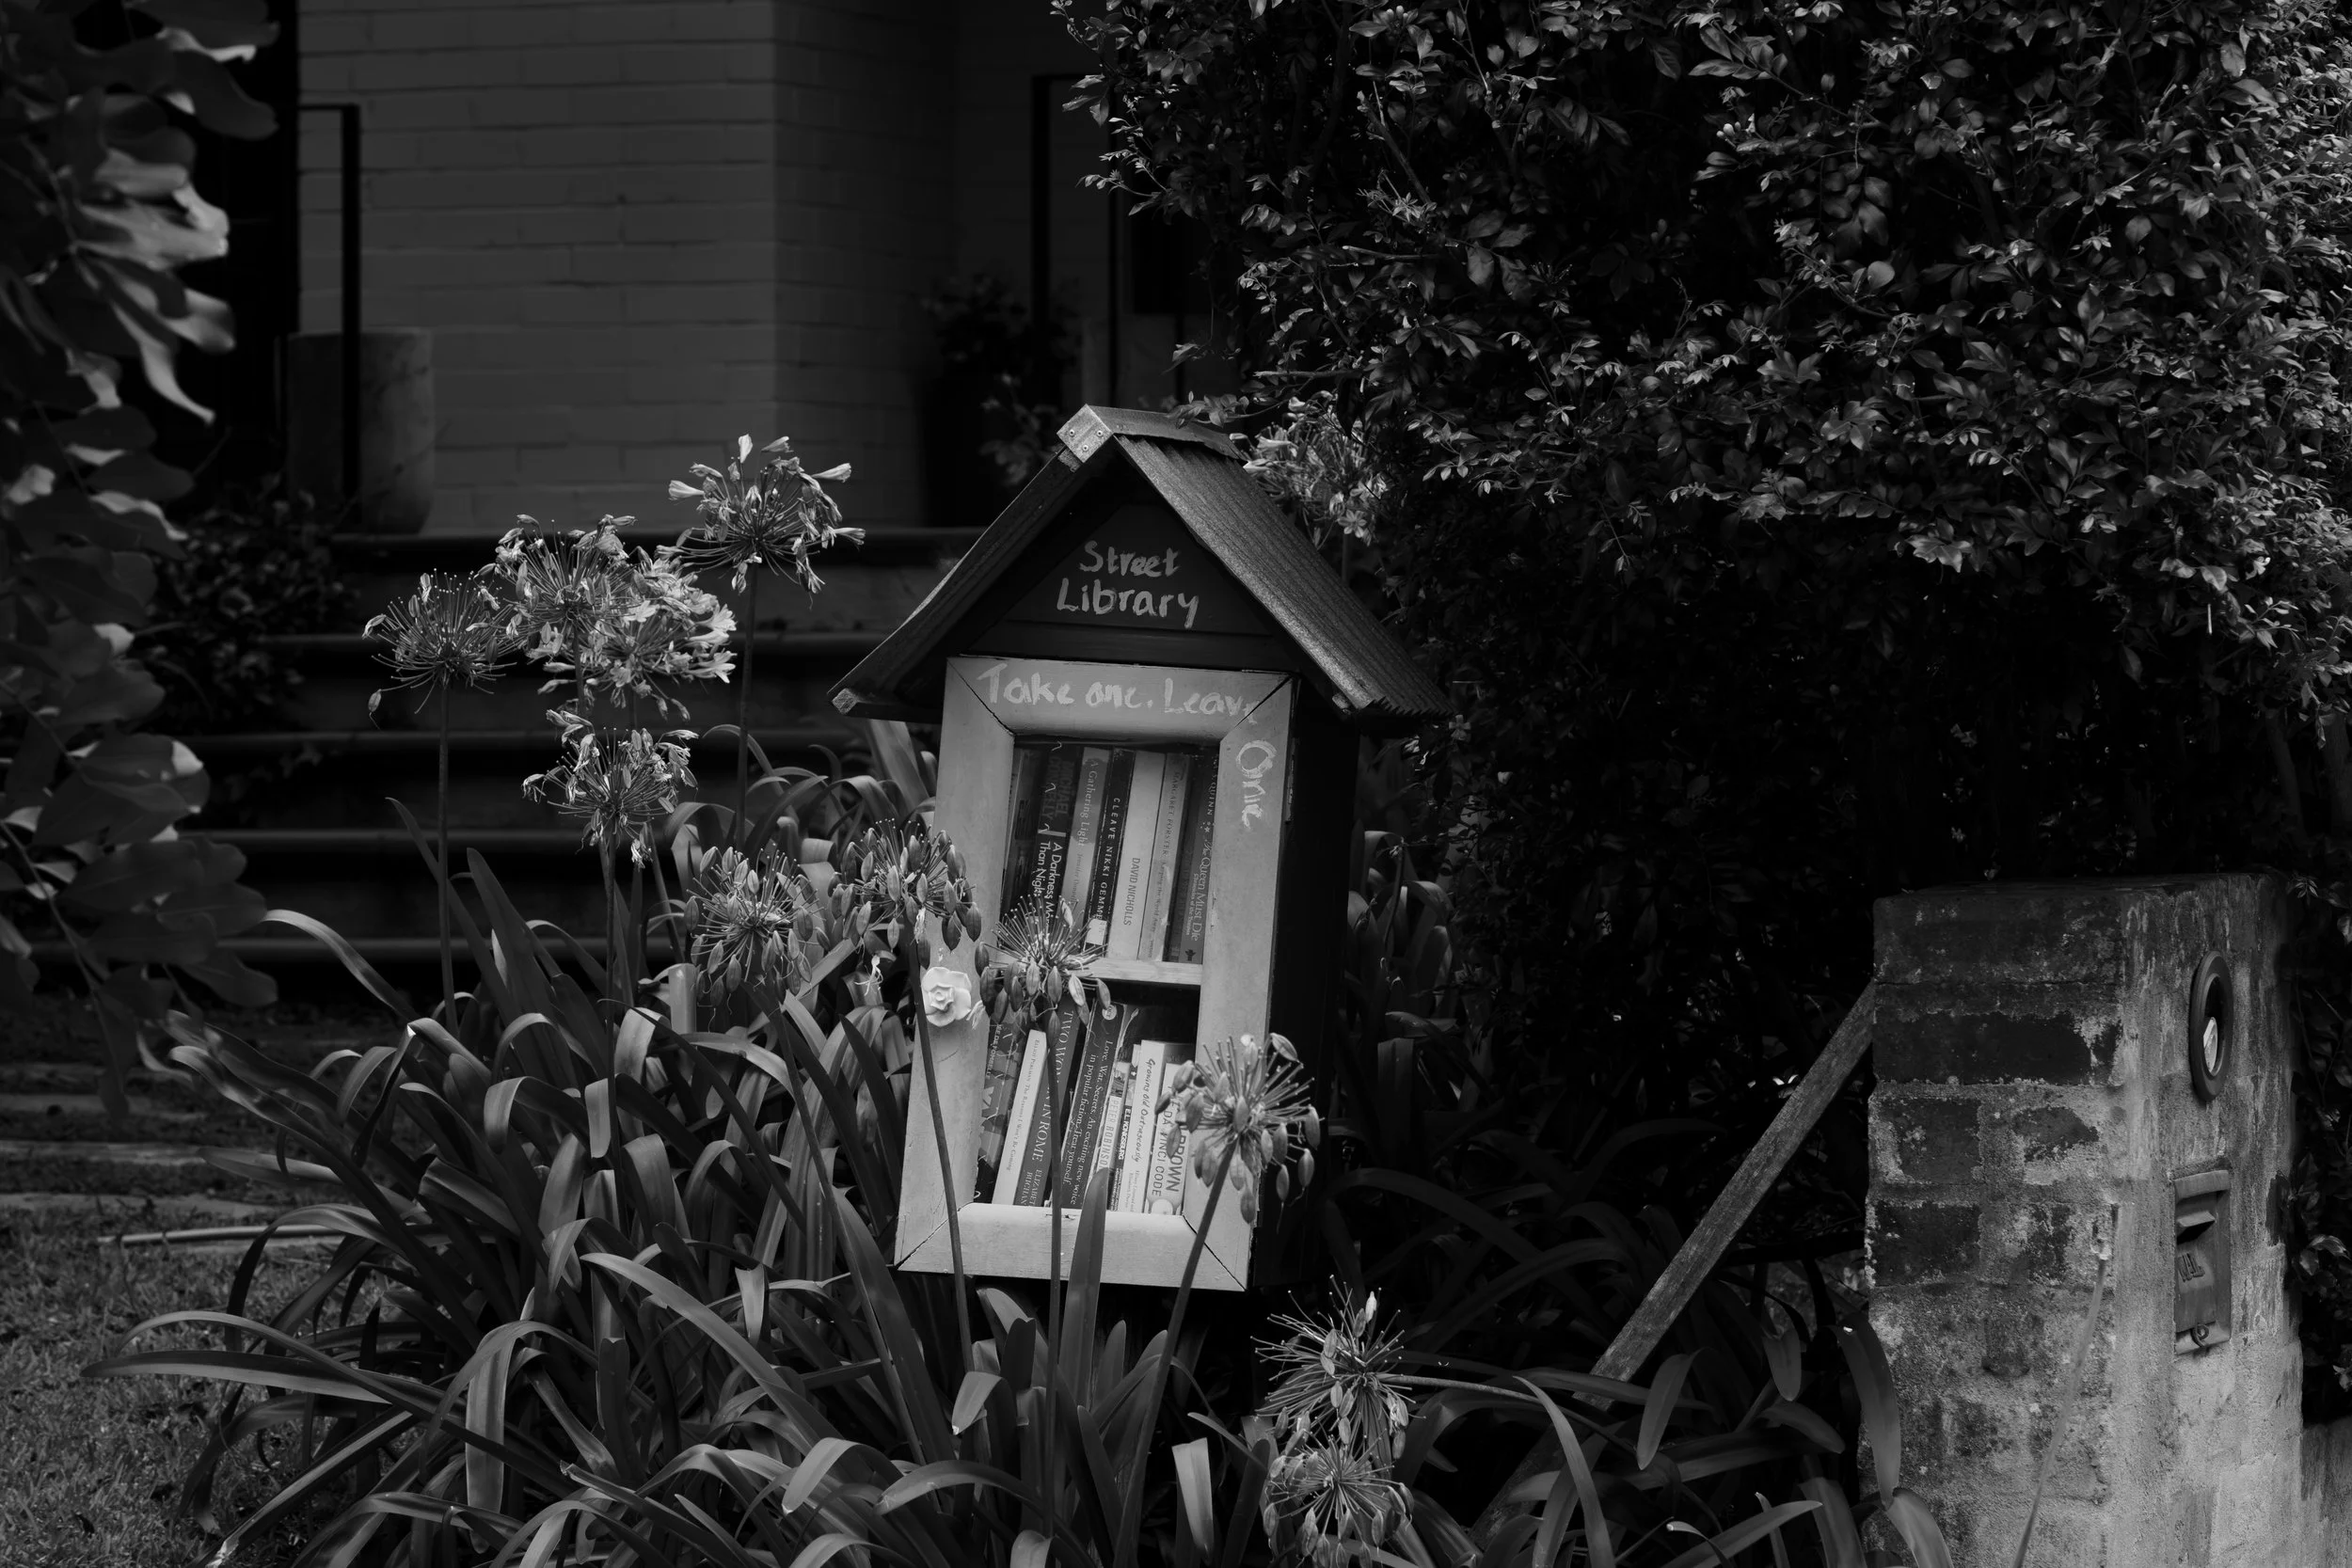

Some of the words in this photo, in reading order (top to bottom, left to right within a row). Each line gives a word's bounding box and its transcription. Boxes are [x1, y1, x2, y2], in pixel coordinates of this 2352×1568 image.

[1079, 540, 1183, 578] Street
[1057, 578, 1200, 628] Library
[976, 662, 1074, 705] Take
[1085, 678, 1153, 709] one.
[1080, 770, 1097, 819] Gathering
[1168, 770, 1181, 816] MARGARET
[1207, 781, 1216, 816] QUINN
[1235, 739, 1279, 831] One
[1076, 822, 1089, 847] Light
[1108, 797, 1120, 840] CLEAVE
[1053, 843, 1063, 852] A
[1162, 817, 1173, 856] FORSTER
[1038, 840, 1052, 866] Than
[1102, 846, 1113, 877] NIKKI
[1031, 866, 1046, 897] Nigh
[1045, 853, 1063, 900] Darkness
[1129, 857, 1140, 883] DAVID
[1198, 856, 1211, 889] Queen
[1123, 884, 1136, 926] NICHOLLS
[1194, 893, 1207, 920] Must
[1191, 922, 1203, 942] Die
[1057, 1009, 1074, 1043] TWO
[1089, 1054, 1098, 1063] in
[1101, 1039, 1113, 1062] Love.
[1082, 1064, 1095, 1096] popular
[1097, 1064, 1108, 1084] War.
[1143, 1058, 1156, 1091] Growing
[1041, 1102, 1054, 1117] IN
[1090, 1085, 1104, 1116] Secrets.
[1142, 1093, 1151, 1105] Old
[1087, 1117, 1096, 1131] An
[1163, 1110, 1172, 1125] DA
[1032, 1120, 1050, 1163] ROME
[1071, 1127, 1083, 1149] Treat
[1077, 1132, 1092, 1164] exciting
[1099, 1125, 1115, 1169] ROBINSO
[1132, 1108, 1149, 1162] Outrageously
[1157, 1131, 1168, 1161] VINCI
[1062, 1150, 1077, 1186] yourself.
[1075, 1166, 1084, 1183] new
[1152, 1164, 1164, 1196] CODE
[1028, 1169, 1042, 1207] ELIZABET
[1070, 1184, 1081, 1206] voice
